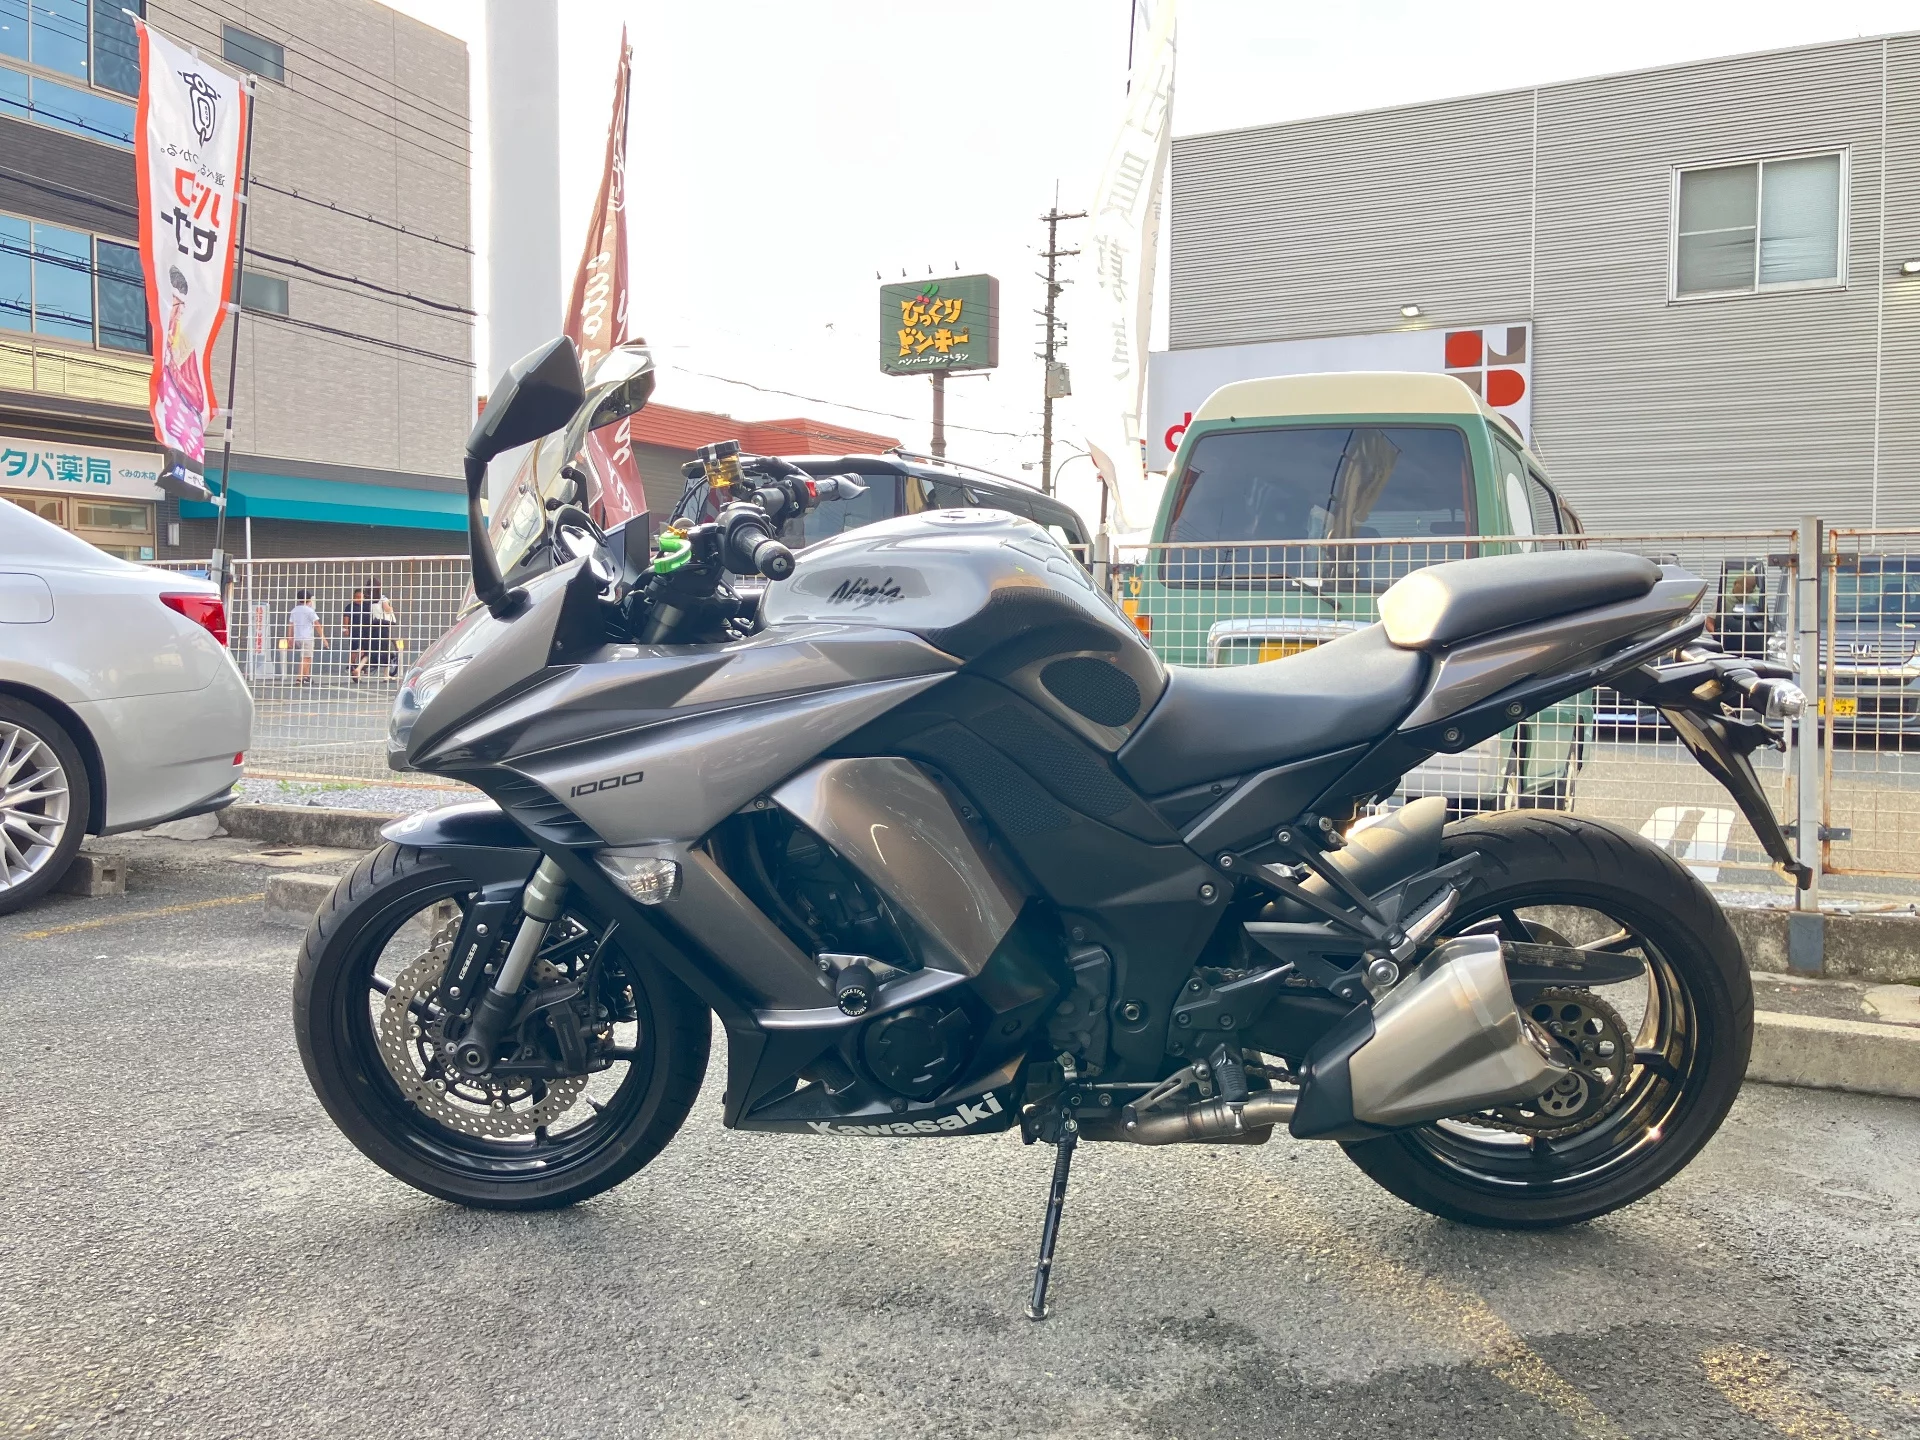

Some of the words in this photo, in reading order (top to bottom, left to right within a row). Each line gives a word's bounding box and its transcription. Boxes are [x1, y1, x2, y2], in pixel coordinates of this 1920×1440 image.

[901, 298, 963, 327] びっくり
[897, 327, 969, 357] ドンキー
[825, 576, 905, 611] Ninja
[570, 771, 644, 798] 1000
[806, 1091, 1004, 1136] Kawasaki
